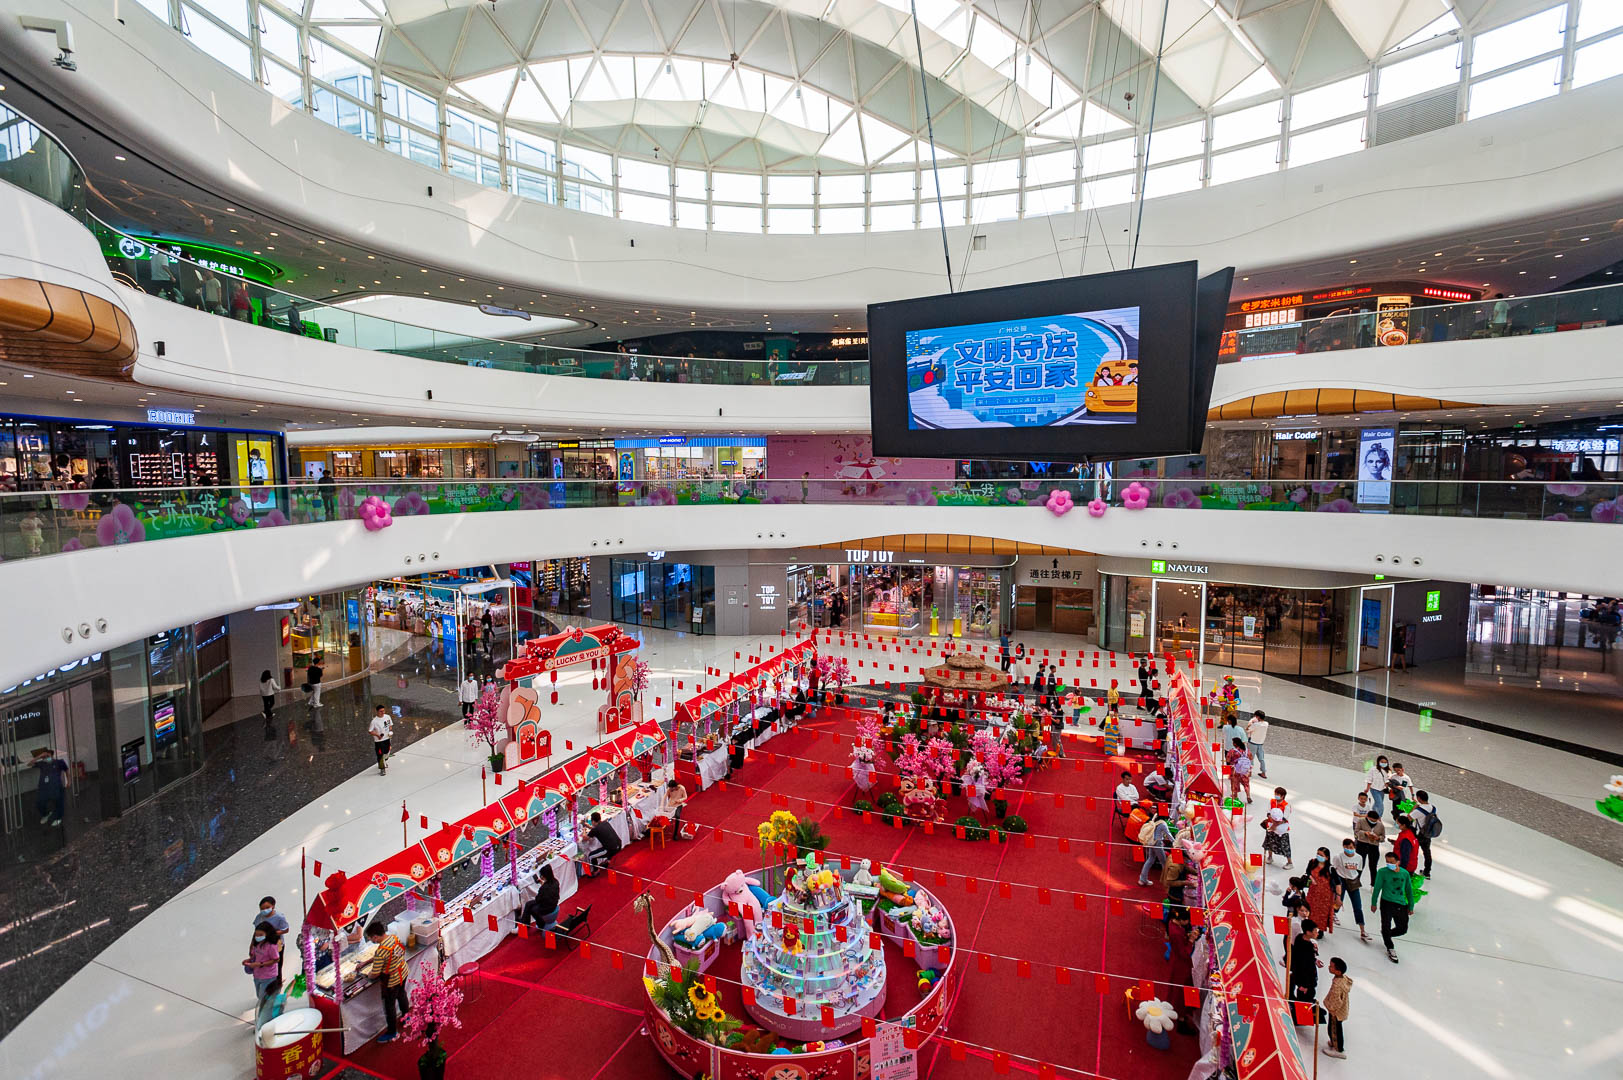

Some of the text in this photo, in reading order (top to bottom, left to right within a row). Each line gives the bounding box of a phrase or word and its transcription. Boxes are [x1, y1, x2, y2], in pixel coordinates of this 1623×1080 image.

[954, 332, 1077, 366] 文明守法
[954, 361, 1077, 394] 平安回家
[1275, 431, 1317, 440] Hair Code
[845, 549, 869, 562] TOP
[1168, 563, 1208, 574] NAYUKI
[1030, 569, 1082, 580] 通往货梯厅
[761, 585, 775, 593] TOP
[1422, 614, 1442, 622] NAYUKI
[556, 655, 578, 666] LUCKY
[586, 650, 599, 658] YOU
[28, 711, 41, 719] Pro
